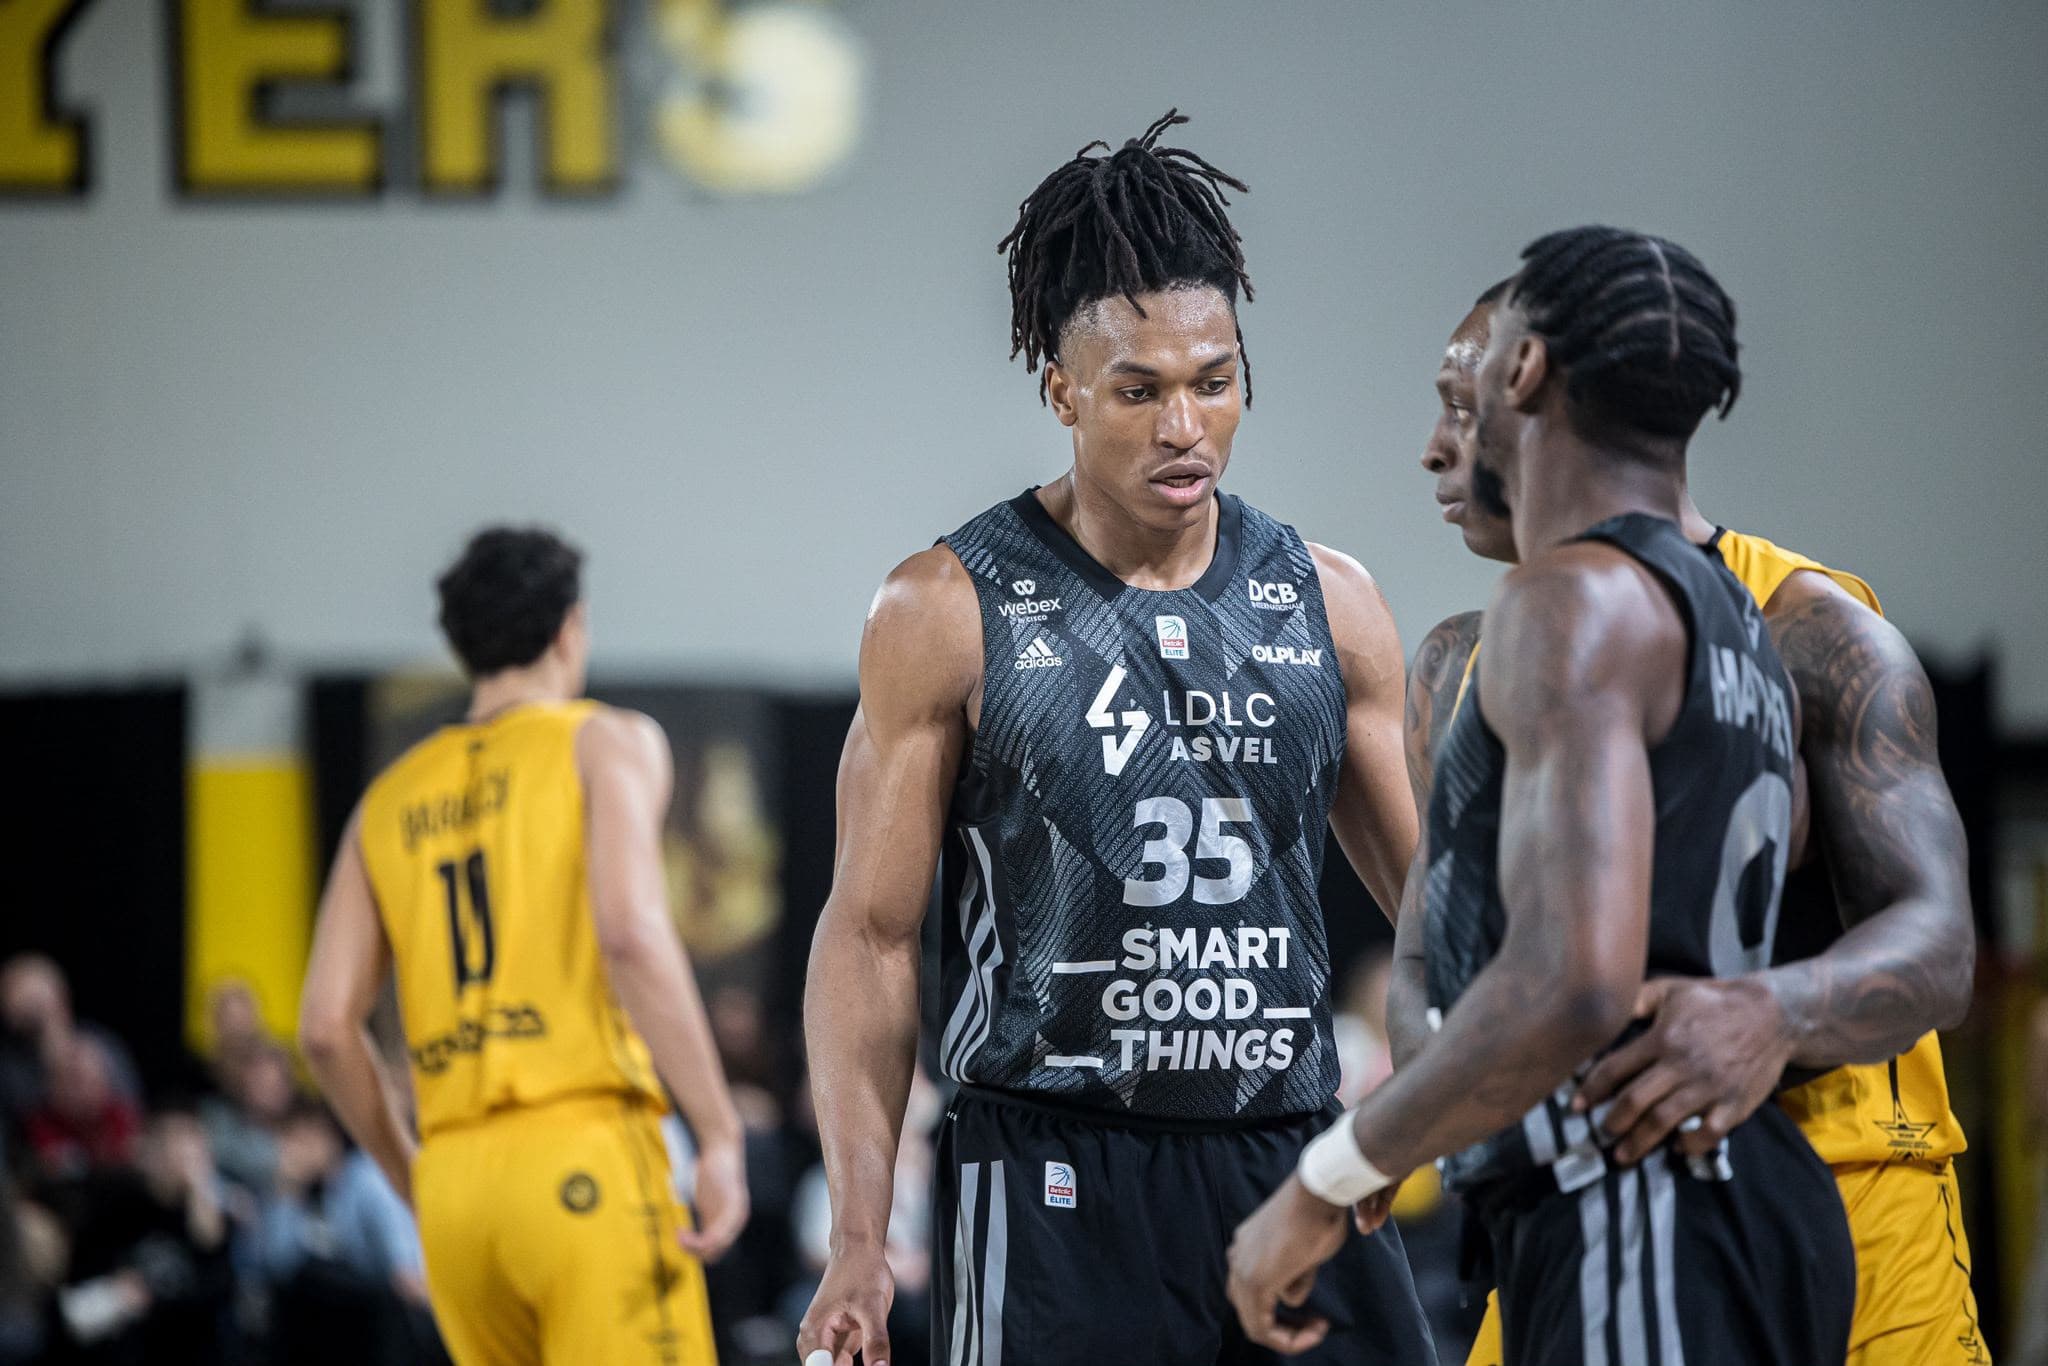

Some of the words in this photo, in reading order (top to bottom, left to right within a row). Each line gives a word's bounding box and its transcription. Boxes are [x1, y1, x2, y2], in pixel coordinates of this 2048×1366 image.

[998, 597, 1063, 617] webex
[1248, 578, 1298, 605] DCB
[1014, 656, 1063, 670] adidas
[1251, 644, 1322, 667] OLPLAY
[1163, 689, 1277, 728] LDLC
[1169, 735, 1278, 764] ASVEL
[1122, 796, 1254, 907] 35
[1121, 927, 1292, 971] SMART
[1101, 977, 1258, 1022] GOOD
[1110, 1028, 1295, 1072] THINGS
